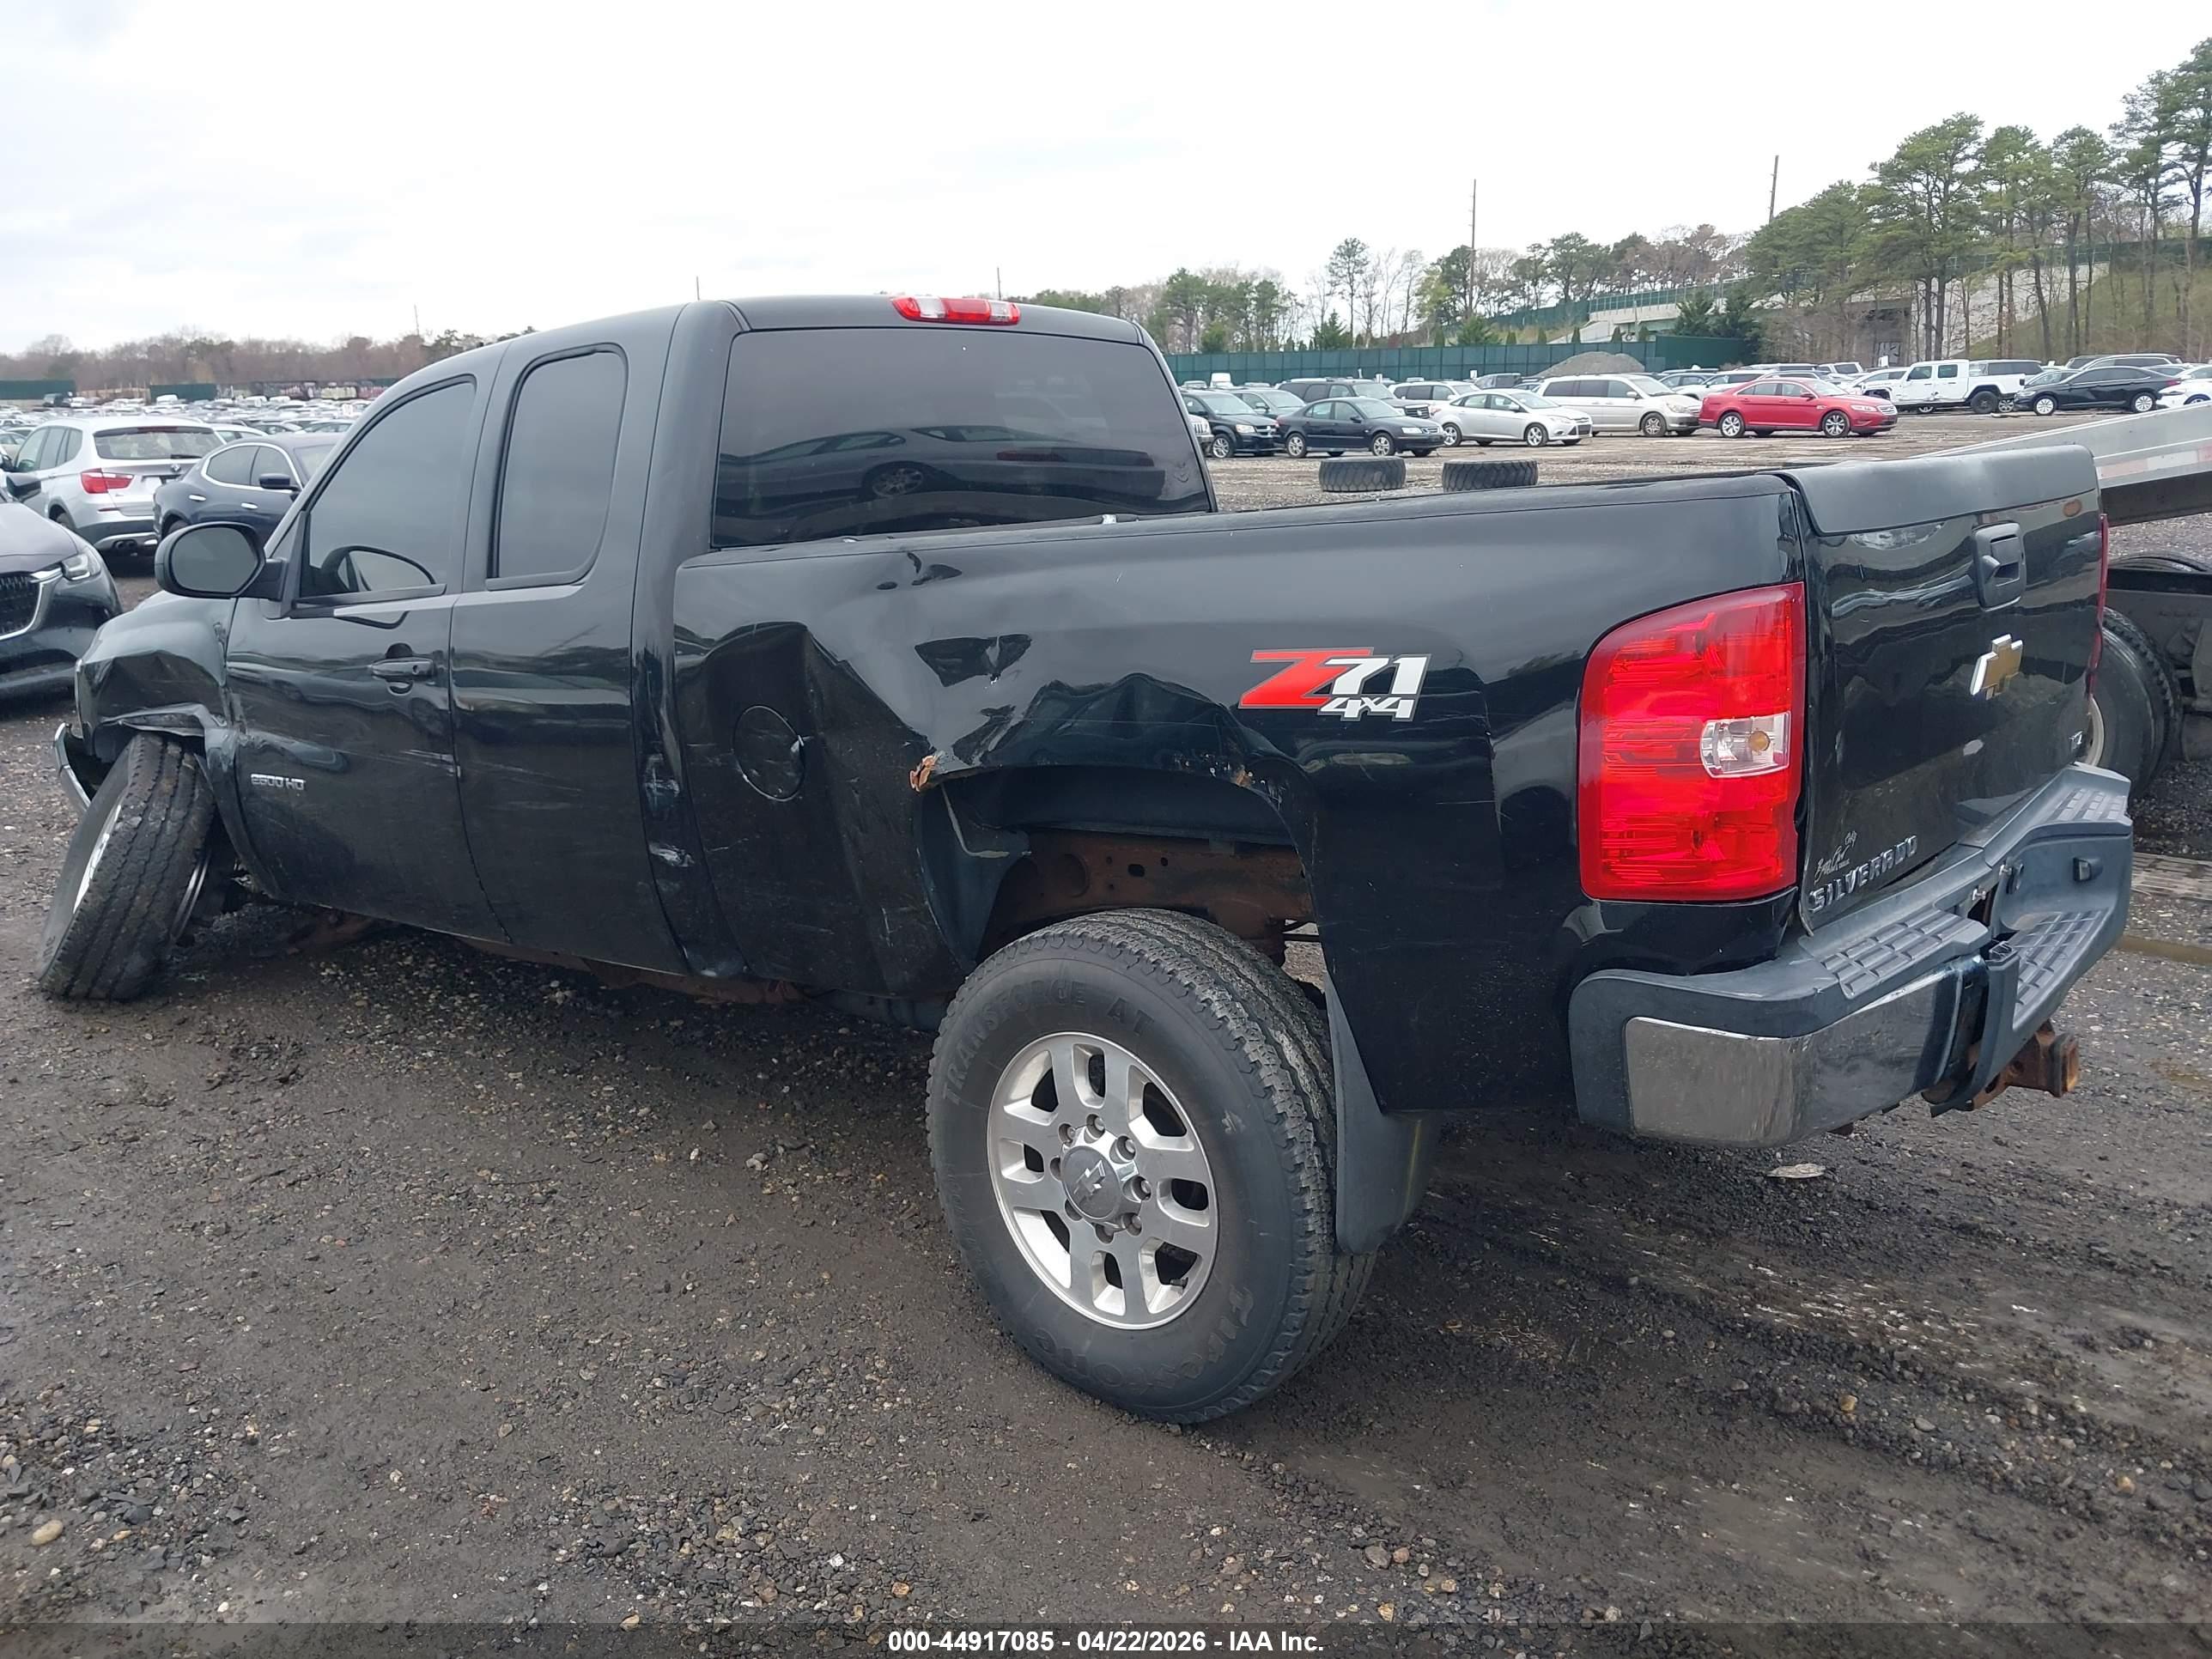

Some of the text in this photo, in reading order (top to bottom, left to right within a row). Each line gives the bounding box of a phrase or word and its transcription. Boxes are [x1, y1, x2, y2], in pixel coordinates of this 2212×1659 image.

[1238, 647, 1431, 709] Z71
[1808, 835, 1918, 913] SILVERADO
[1106, 996, 1155, 1037] AT
